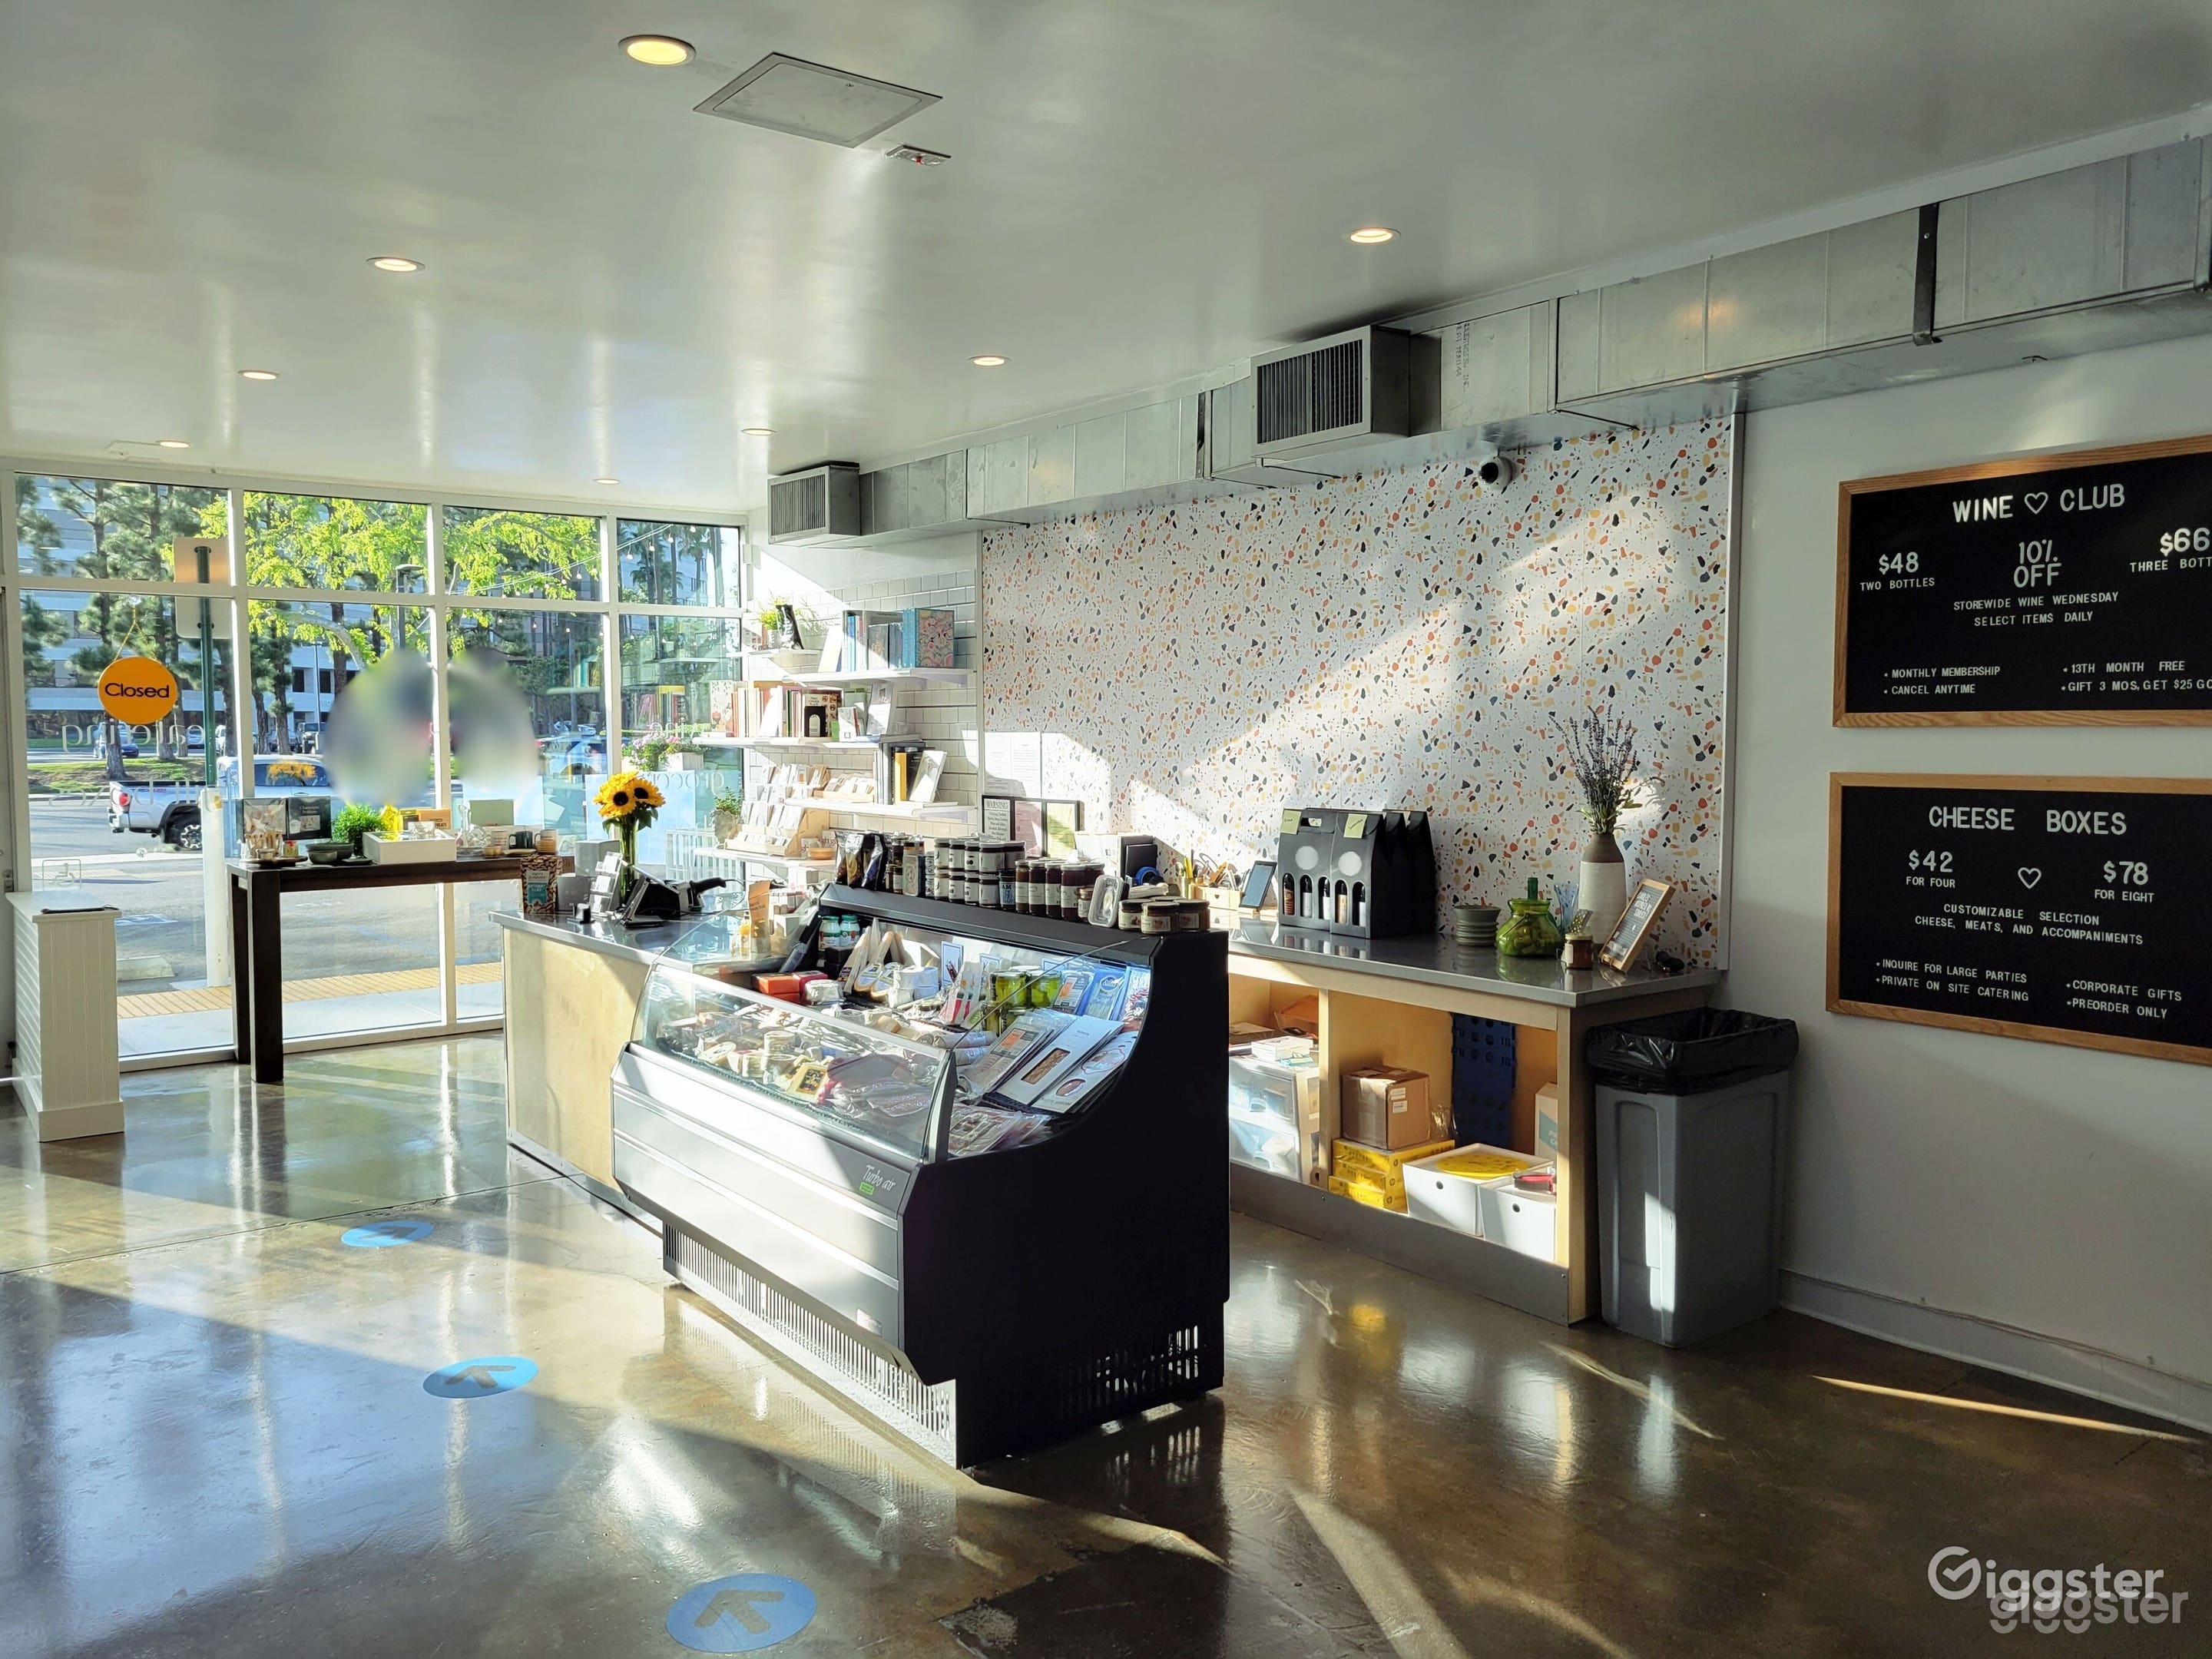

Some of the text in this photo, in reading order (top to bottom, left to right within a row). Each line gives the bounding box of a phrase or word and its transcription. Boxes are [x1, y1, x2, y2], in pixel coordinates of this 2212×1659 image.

[1952, 483, 2125, 523] WINE CLUB
[2160, 527, 2210, 557] $66
[1879, 551, 1919, 575] $48
[2129, 559, 2168, 573] THREE
[1859, 577, 1935, 591] TWO BOTTLES
[2013, 562, 2062, 588] OFF
[1953, 591, 2119, 611] STOREWIDE WINE WEDNESDAY
[1974, 611, 2093, 627] SELECT ITEMS DAILY
[1892, 665, 2001, 678] MONTHLY MEMBERSHIP
[2071, 661, 2186, 674] 13TH MONTH FREE
[104, 682, 170, 699] Closed
[1891, 684, 1975, 695] CANCEL ANYTIME
[2068, 681, 2092, 691] GIFT
[2099, 681, 2106, 691] 3
[2174, 678, 2193, 690] $25
[1929, 806, 2127, 836] CHEESE BOXES
[1908, 849, 1953, 873] $42
[1906, 876, 1955, 889] FOR FOUR
[2103, 860, 2149, 886] $78
[2094, 889, 2154, 903] FOR EIGHT
[1943, 903, 2099, 926] CUSTOMIZABLE SELECTION
[2012, 923, 2034, 935] AND
[2041, 926, 2144, 945] ACCOMPANIMENTS
[1883, 959, 2027, 983] INQUIRE FOR LARGE PARTIES
[1882, 975, 2029, 1002] PRIVATE ON SITE CATERING
[2072, 979, 2182, 1002] CORPORATE GIFTS
[2072, 997, 2167, 1019] PREORDER ONLY
[863, 1164, 883, 1187] Turbo
[881, 1177, 896, 1191] air
